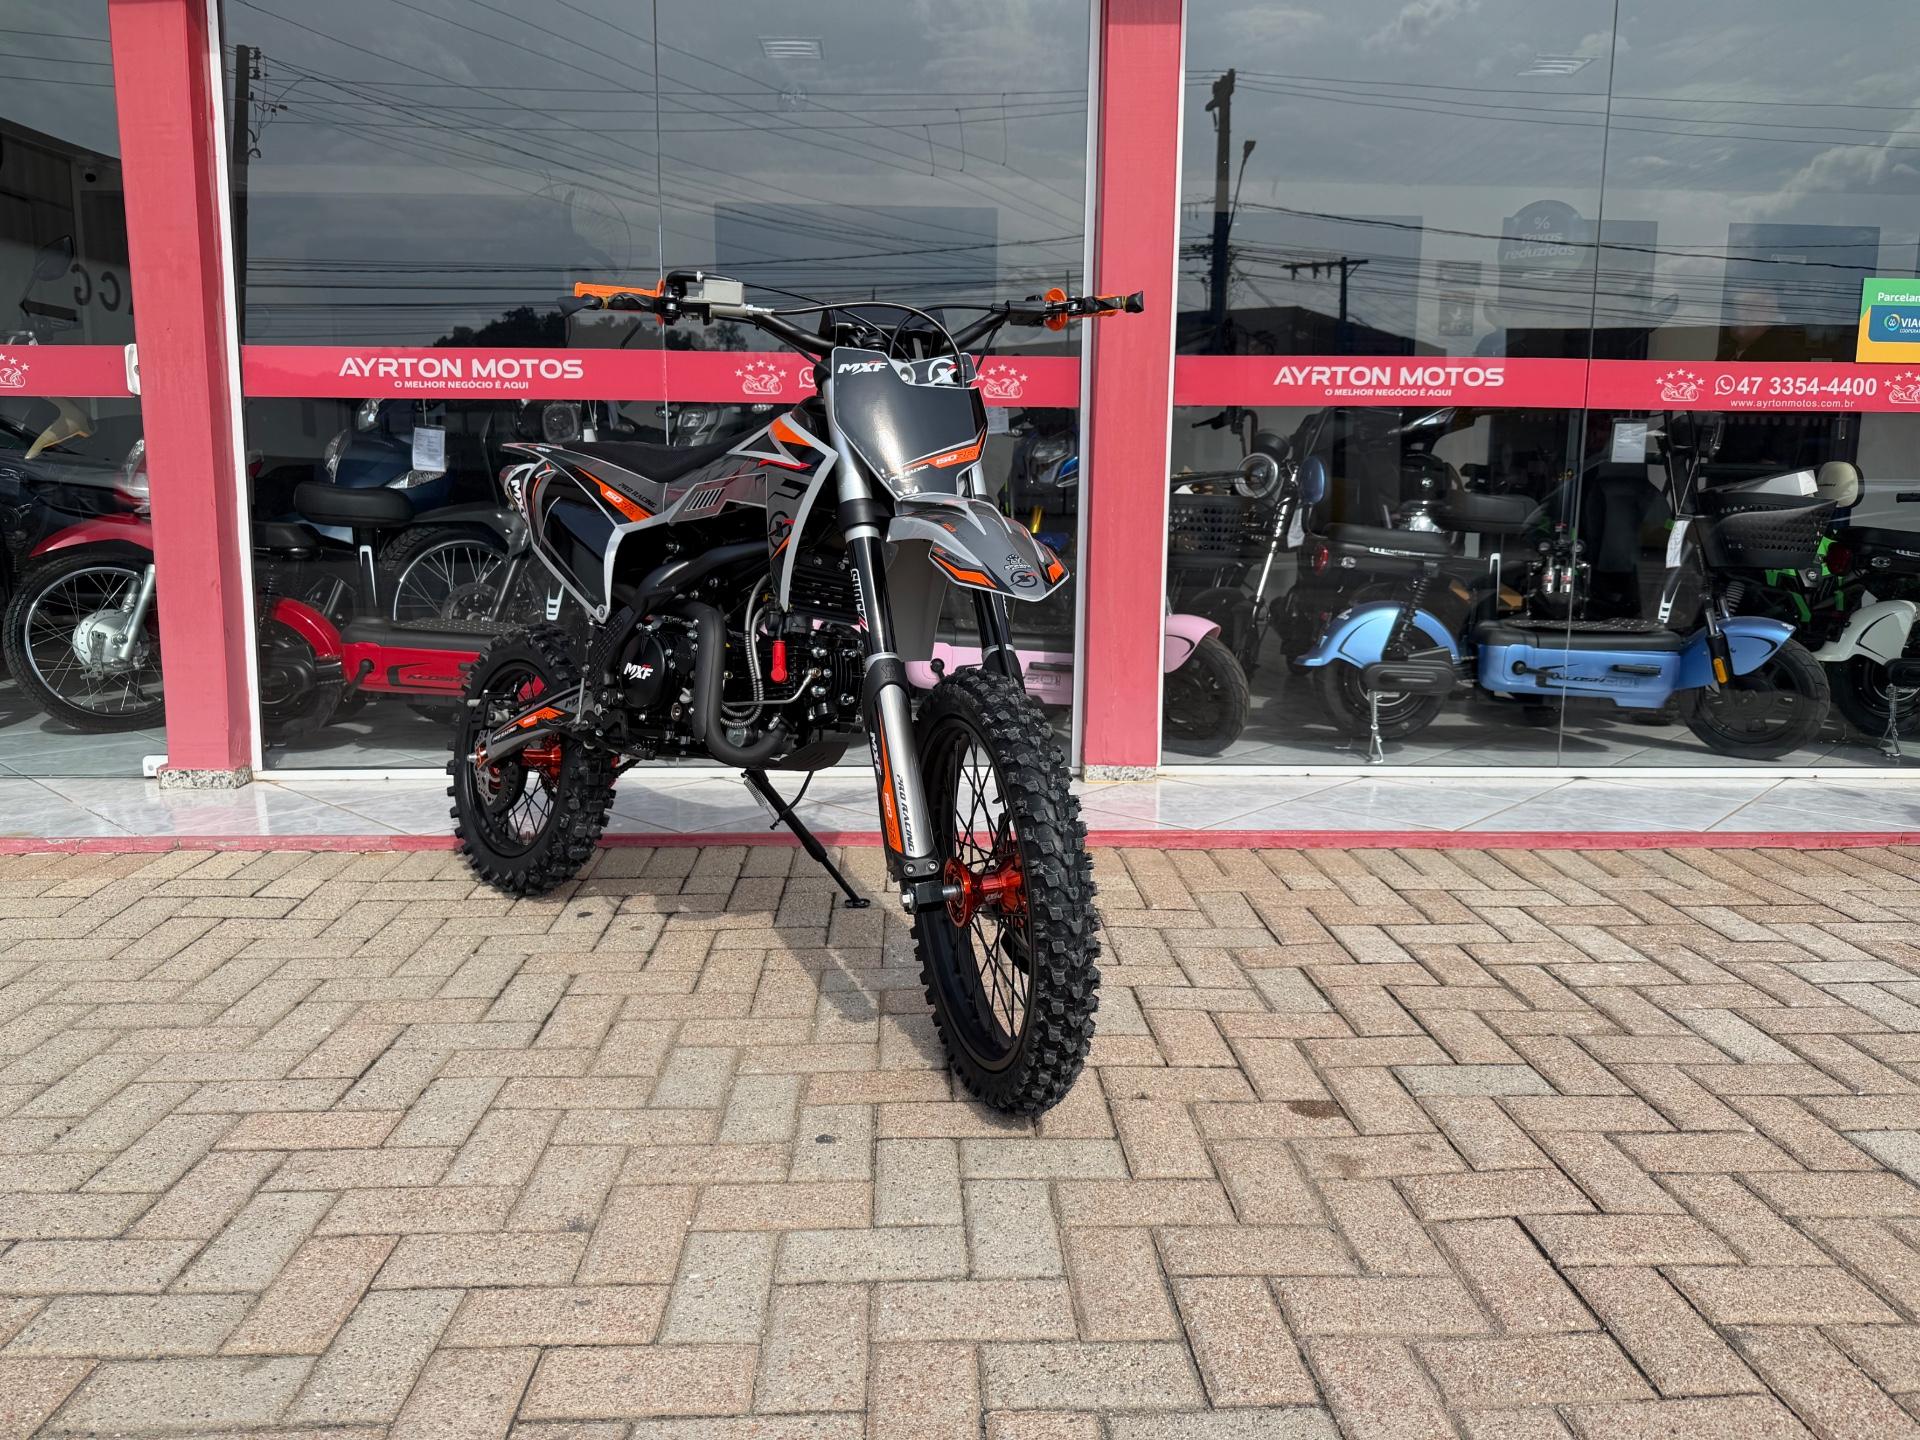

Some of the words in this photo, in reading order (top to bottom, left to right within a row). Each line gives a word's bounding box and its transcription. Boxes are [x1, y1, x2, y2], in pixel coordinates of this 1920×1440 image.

[1503, 244, 1577, 261] reduzidas
[1900, 317, 1920, 328] VIA
[338, 357, 462, 378] AYRTON
[471, 358, 584, 379] MOTOS
[837, 360, 889, 376] MXF
[1272, 366, 1391, 386] AYRTON
[1399, 366, 1505, 387] MOTOS
[393, 380, 402, 389] O
[404, 381, 446, 389] MELHOR
[447, 379, 493, 389] NEGÓCIO
[495, 379, 501, 389] É
[503, 381, 529, 390] AQUI
[1324, 388, 1333, 396] O
[1334, 388, 1374, 397] MELHOR
[1375, 387, 1419, 397] NEGÓCIO
[1420, 387, 1427, 397] É
[1429, 388, 1452, 397] AQUI
[1736, 376, 1763, 395] 47
[1768, 376, 1878, 396] 3354-4400
[1730, 399, 1855, 409] www.ayrtonmotos.com.br
[623, 663, 654, 681] MXF
[902, 799, 915, 852] RACING
